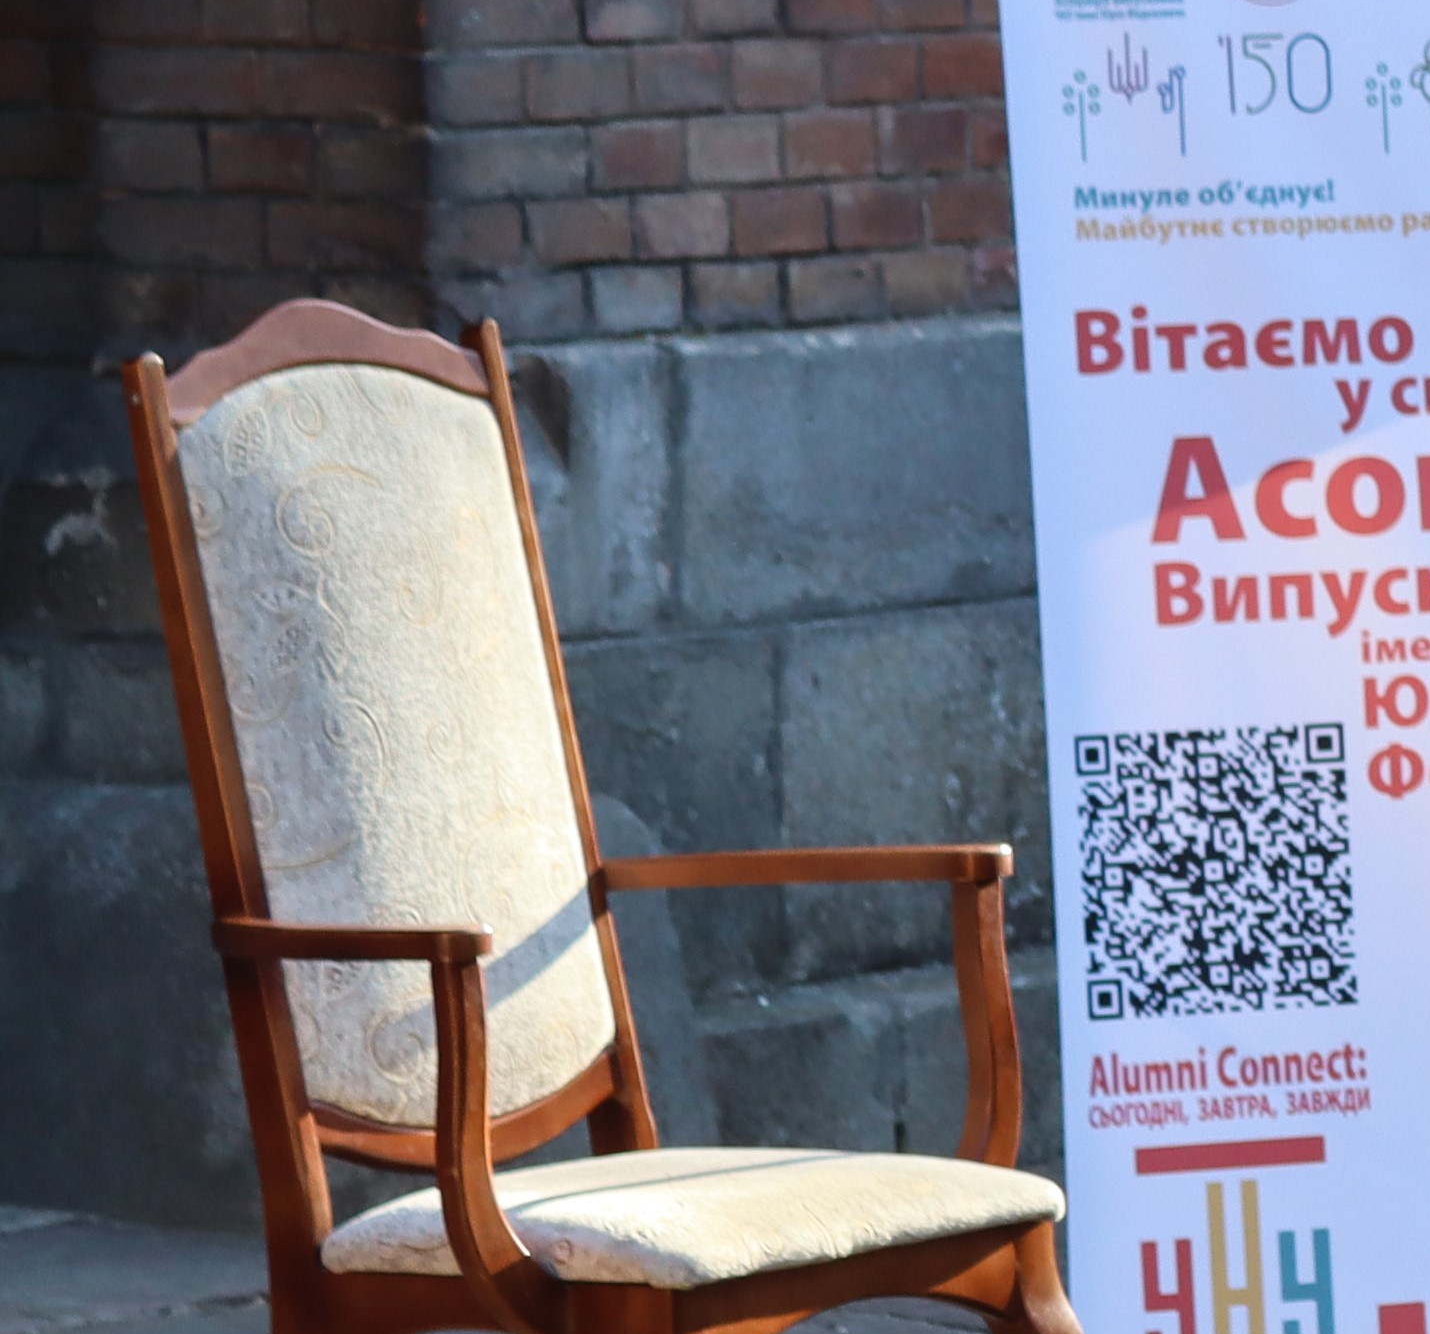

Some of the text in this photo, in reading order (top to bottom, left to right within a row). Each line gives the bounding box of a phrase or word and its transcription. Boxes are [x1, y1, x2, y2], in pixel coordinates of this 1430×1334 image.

[1073, 185, 1190, 213] Минуле
[1075, 214, 1226, 245] Майбутнє
[1231, 214, 1394, 242] створюємо
[1074, 304, 1415, 376] Вітаємо
[1334, 378, 1372, 434] у
[1089, 1041, 1368, 1098] Alumni Connect:
[1089, 1087, 1372, 1130] СЬОГОДНІ, ЗАВТРА, ЗАВЖДИ
